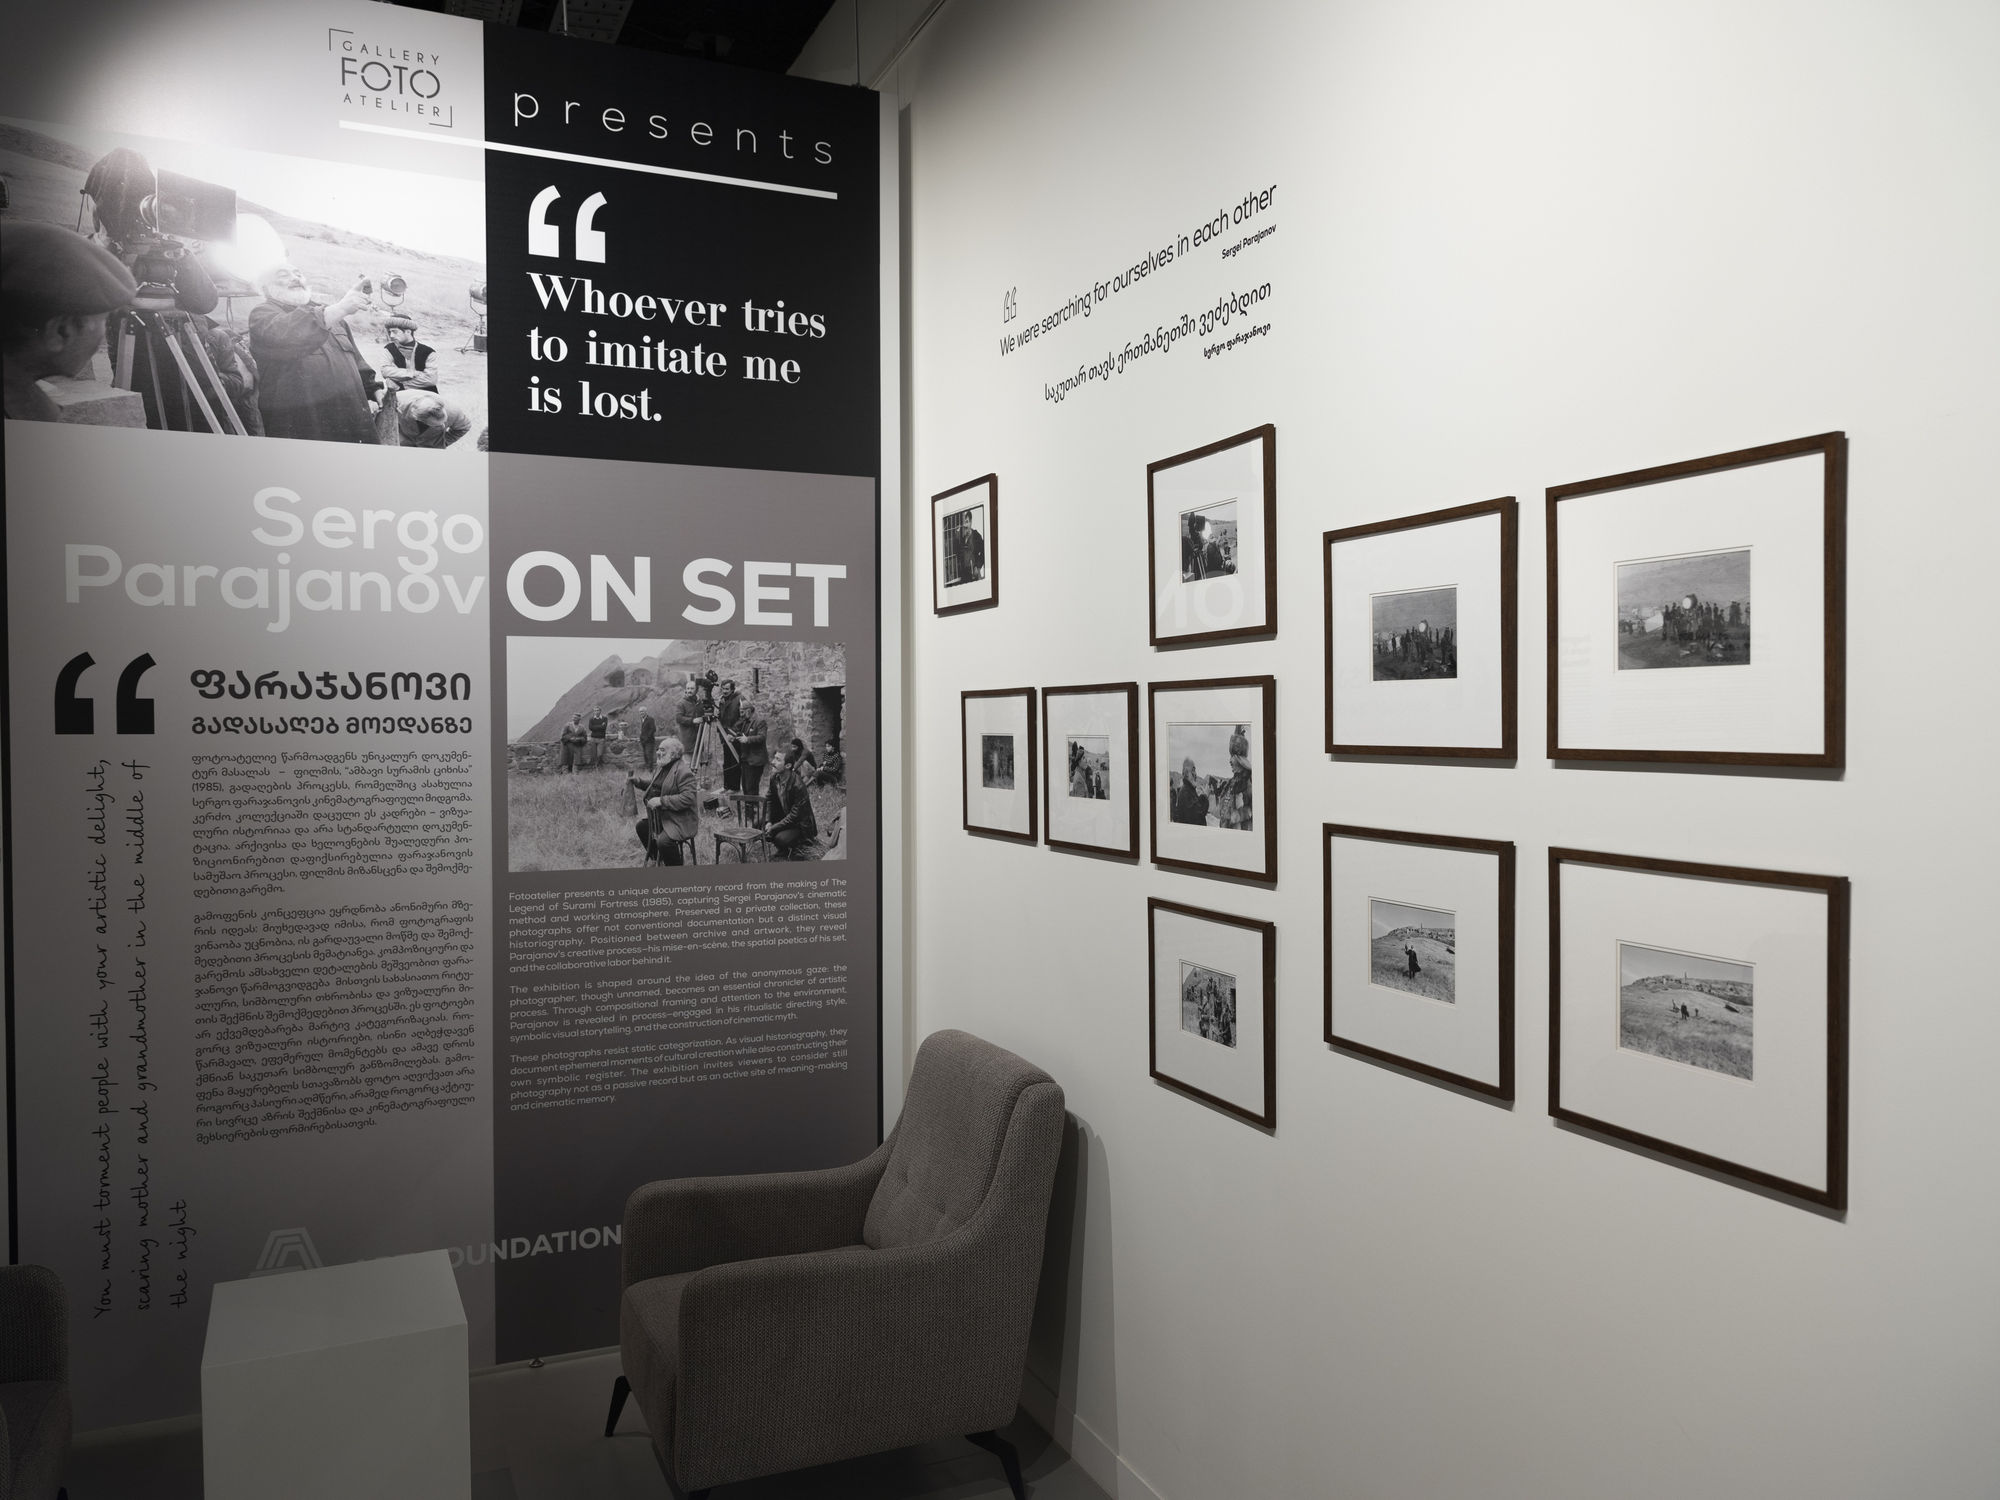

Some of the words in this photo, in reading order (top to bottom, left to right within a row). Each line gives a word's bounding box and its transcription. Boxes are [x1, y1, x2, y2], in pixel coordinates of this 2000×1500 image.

[342, 40, 439, 65] GALLERY
[341, 57, 441, 99] FOTO
[343, 93, 440, 117] ATELIER
[514, 92, 832, 164] presents
[1222, 240, 1242, 259] Sergei
[1243, 224, 1276, 248] Parajanov
[1000, 333, 1015, 356] We
[1017, 322, 1040, 347] were
[1041, 292, 1091, 334] searching
[1094, 281, 1111, 304] for
[1113, 244, 1174, 293] ourselves
[1177, 234, 1189, 257] in
[1193, 208, 1229, 247] each
[1233, 184, 1277, 224] other
[526, 272, 727, 327] Whoever
[741, 299, 826, 339] tries
[526, 326, 568, 362] to
[585, 330, 727, 377] imitate
[743, 355, 801, 384] me
[1044, 365, 1087, 404] საკუთარ
[1088, 351, 1115, 381] თავს
[1117, 313, 1196, 374] ერთმანეთში
[1199, 282, 1271, 337] ვეძებდით
[527, 376, 562, 413] is
[578, 381, 662, 422] lost.
[251, 486, 484, 574] Sergo
[64, 543, 486, 633] Parajanov
[506, 550, 651, 623] ON
[681, 557, 847, 627] SET
[190, 669, 471, 701] ფარაჯანოვი
[191, 716, 340, 735] გადასაღებ
[346, 716, 473, 735] მოედანზე
[121, 759, 151, 780] of
[86, 759, 115, 844] delight,
[125, 790, 144, 864] middle
[88, 854, 107, 934] artistic
[126, 873, 145, 914] the
[509, 890, 561, 901] Fotoatelier
[564, 889, 605, 900] presents
[618, 886, 649, 897] unique
[652, 883, 711, 896] documentary
[714, 882, 743, 891] record
[746, 881, 767, 890] from
[769, 880, 784, 889] the
[786, 879, 817, 891] making
[820, 878, 829, 886] of
[831, 877, 847, 886] The
[509, 902, 544, 915] Legend
[548, 902, 559, 911] of
[562, 900, 596, 910] Surami
[600, 898, 638, 908] Fortress
[677, 894, 719, 907] capturing
[723, 893, 750, 905] Sergei
[754, 890, 804, 903] Parajanov's
[807, 889, 846, 898] cinematic
[127, 920, 147, 948] in
[509, 925, 572, 939] photographs
[576, 923, 599, 933] offer
[604, 923, 619, 932] not
[624, 919, 682, 931] conventional
[686, 915, 754, 927] documentation
[758, 915, 773, 923] but
[787, 912, 818, 922] distinct
[822, 911, 847, 920] visual
[96, 944, 115, 989] your
[581, 990, 613, 1003] though
[665, 984, 705, 995] becomes
[708, 984, 720, 992] an
[722, 980, 760, 991] essential
[763, 977, 805, 988] chronicler
[807, 976, 816, 984] of
[818, 974, 847, 984] artistic
[89, 1000, 109, 1048] with
[128, 956, 158, 1091] grandmother
[91, 1057, 119, 1114] people
[510, 1078, 531, 1087] own
[536, 1073, 580, 1086] symbolic
[630, 1066, 648, 1076] The
[652, 1062, 698, 1074] exhibition
[703, 1059, 733, 1069] invites
[737, 1056, 773, 1066] viewers
[776, 1055, 786, 1063] to
[790, 1050, 828, 1061] consider
[832, 1049, 847, 1057] still
[130, 1100, 148, 1144] and
[92, 1122, 111, 1210] torment
[130, 1154, 149, 1227] mother
[93, 1217, 111, 1270] must
[168, 1199, 197, 1260] night
[447, 1224, 622, 1269] OUNDATION
[131, 1238, 160, 1310] scaring
[168, 1268, 188, 1309] the
[94, 1279, 111, 1318] You
